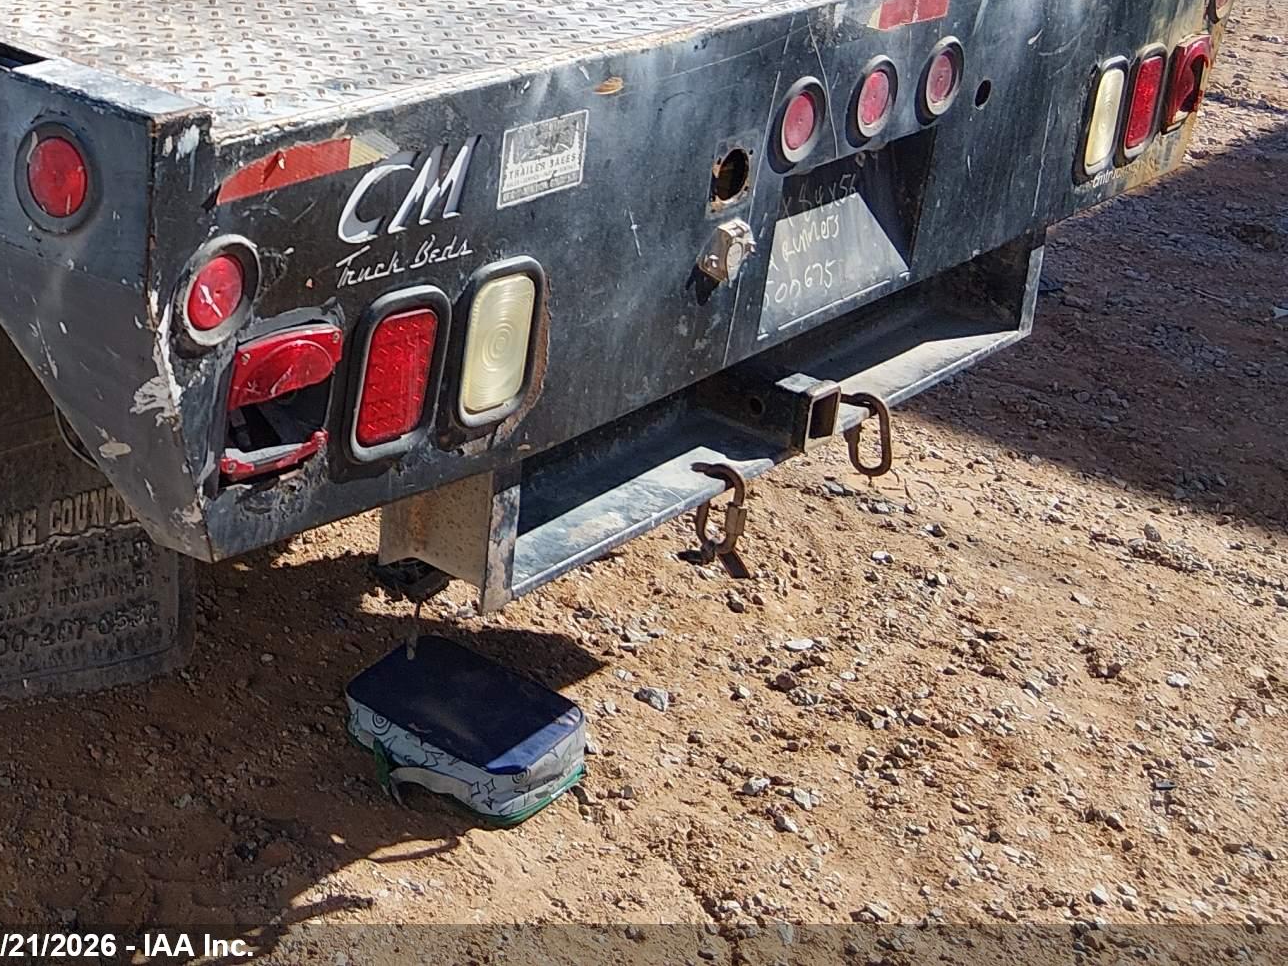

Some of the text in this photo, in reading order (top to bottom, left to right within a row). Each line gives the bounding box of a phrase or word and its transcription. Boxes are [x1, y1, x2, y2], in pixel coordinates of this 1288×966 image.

[338, 135, 482, 244] CM
[336, 234, 473, 289] Truck Beds
